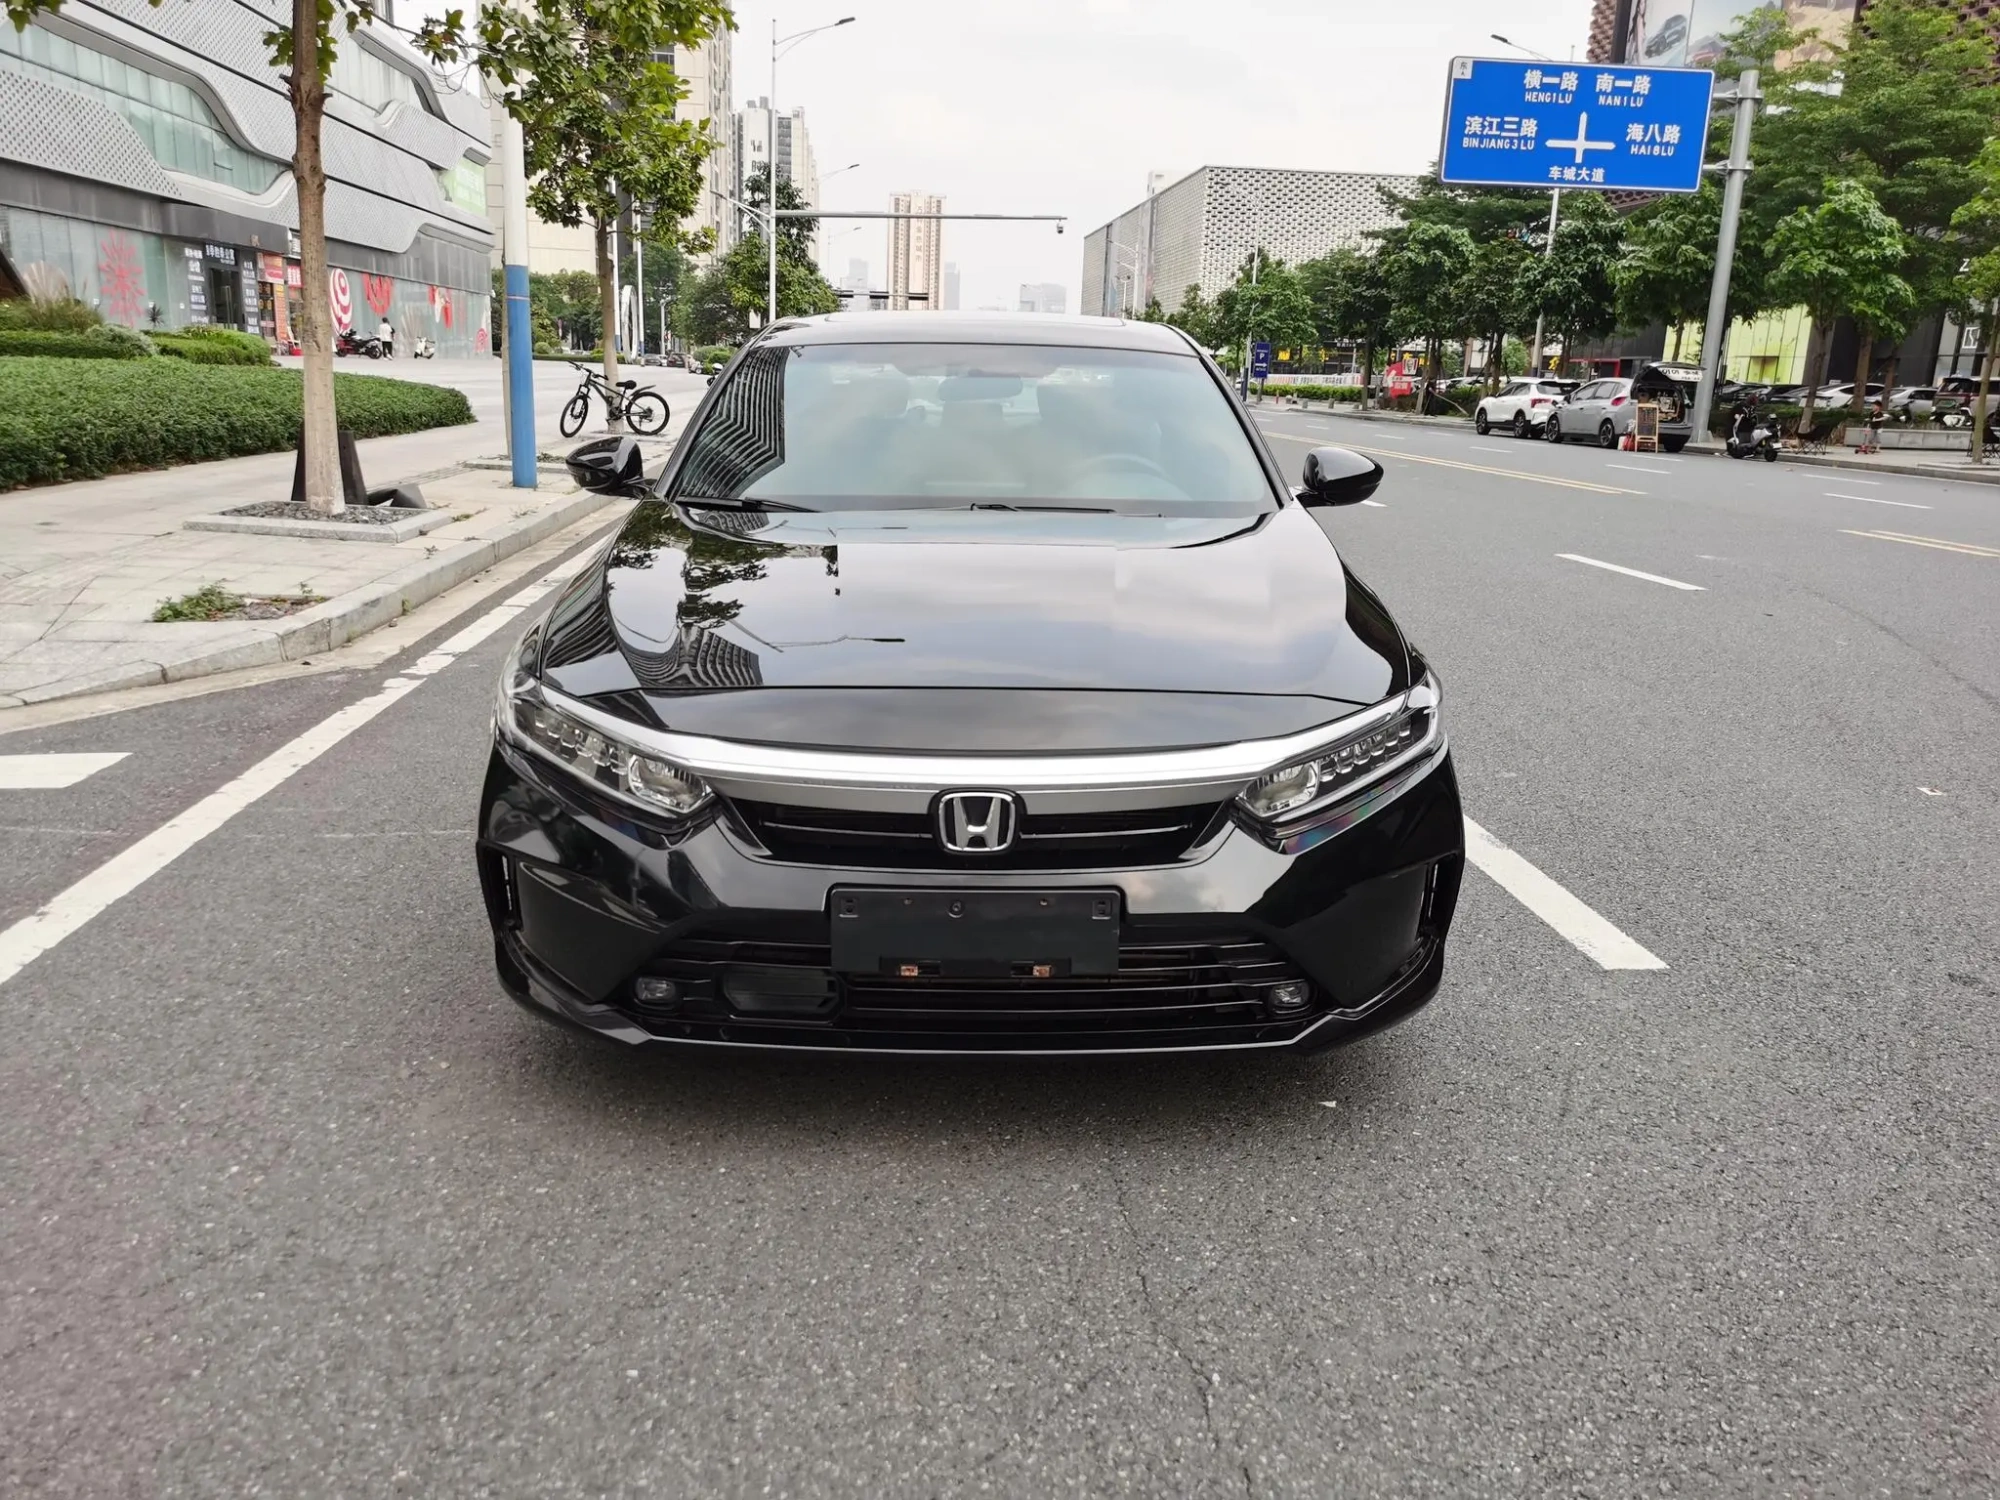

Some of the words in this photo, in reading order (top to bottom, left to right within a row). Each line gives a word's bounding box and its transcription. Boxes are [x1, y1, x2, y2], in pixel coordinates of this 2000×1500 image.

[1523, 69, 1579, 92] 横一路
[1595, 73, 1651, 95] 南一路
[1464, 116, 1538, 138] 滨江三路
[1625, 123, 1681, 144] 海八路
[1548, 166, 1605, 183] 车城大道
